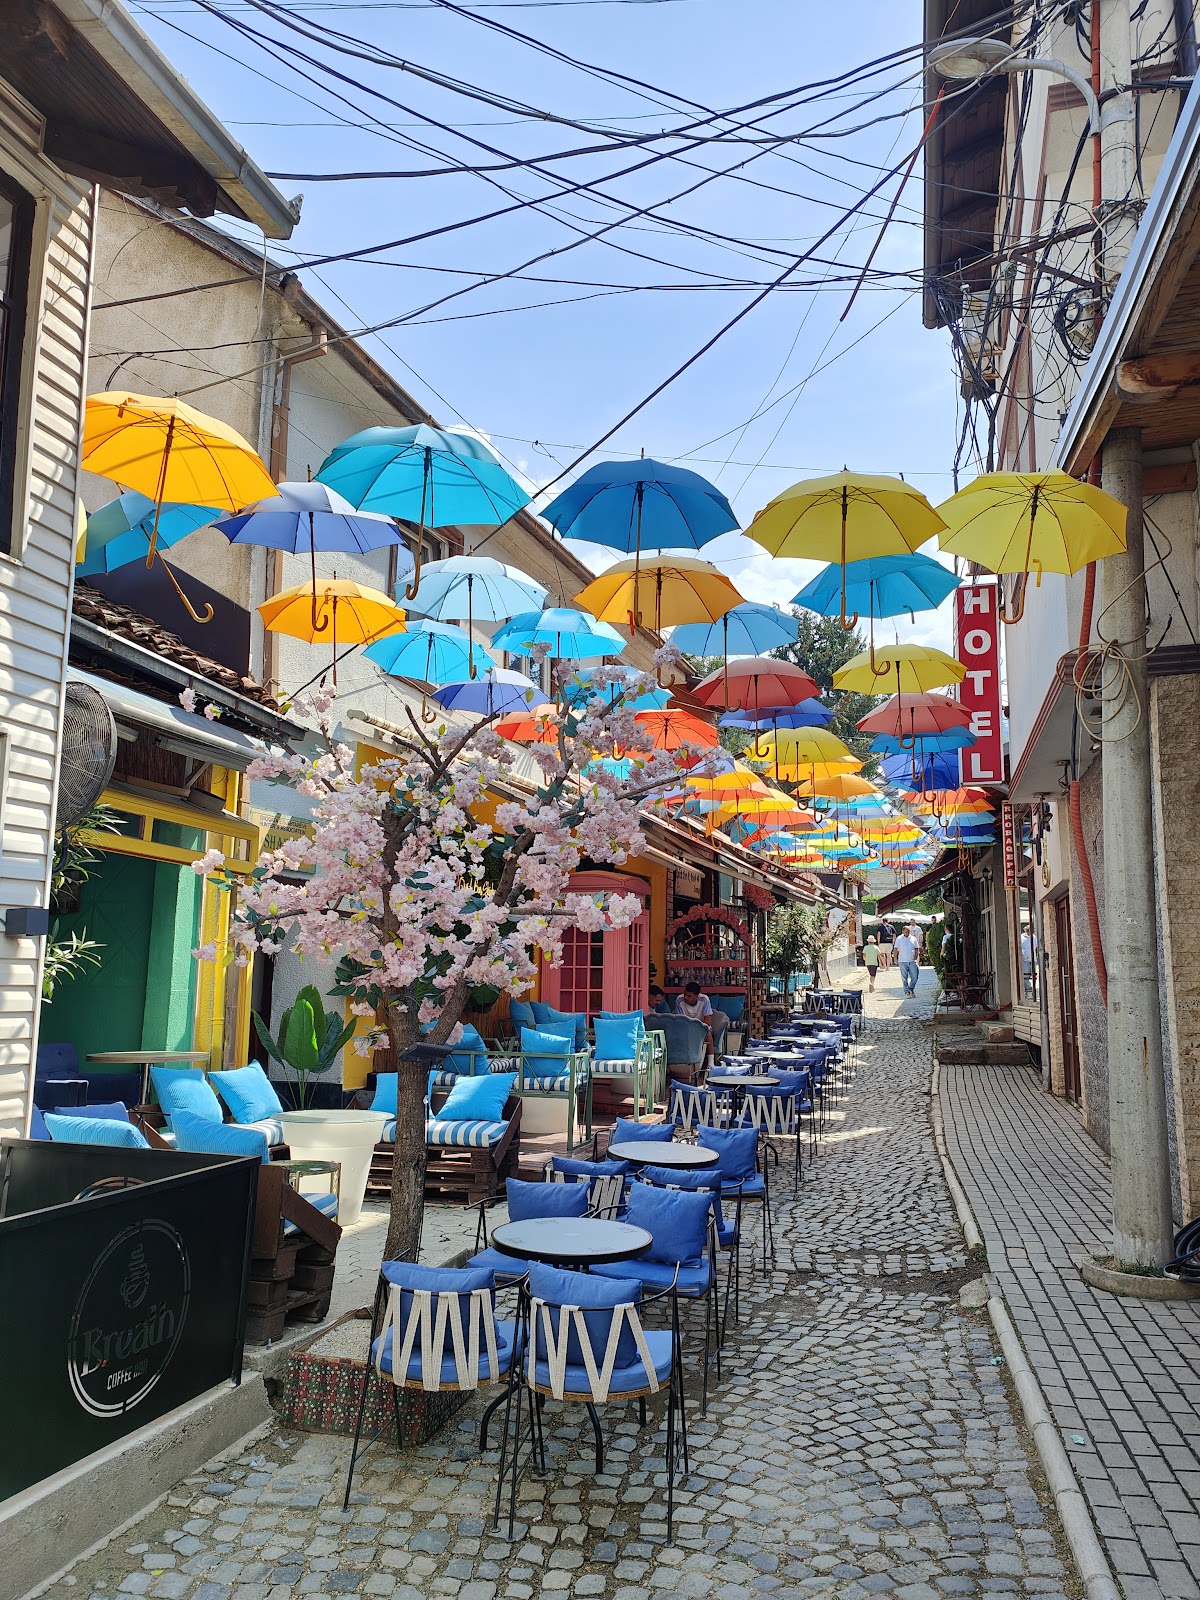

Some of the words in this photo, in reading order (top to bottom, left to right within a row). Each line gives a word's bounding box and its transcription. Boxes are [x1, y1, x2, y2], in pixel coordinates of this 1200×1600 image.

[963, 588, 994, 779] HOTEL
[80, 1301, 175, 1378] Breath
[106, 1365, 133, 1391] COFFEE
